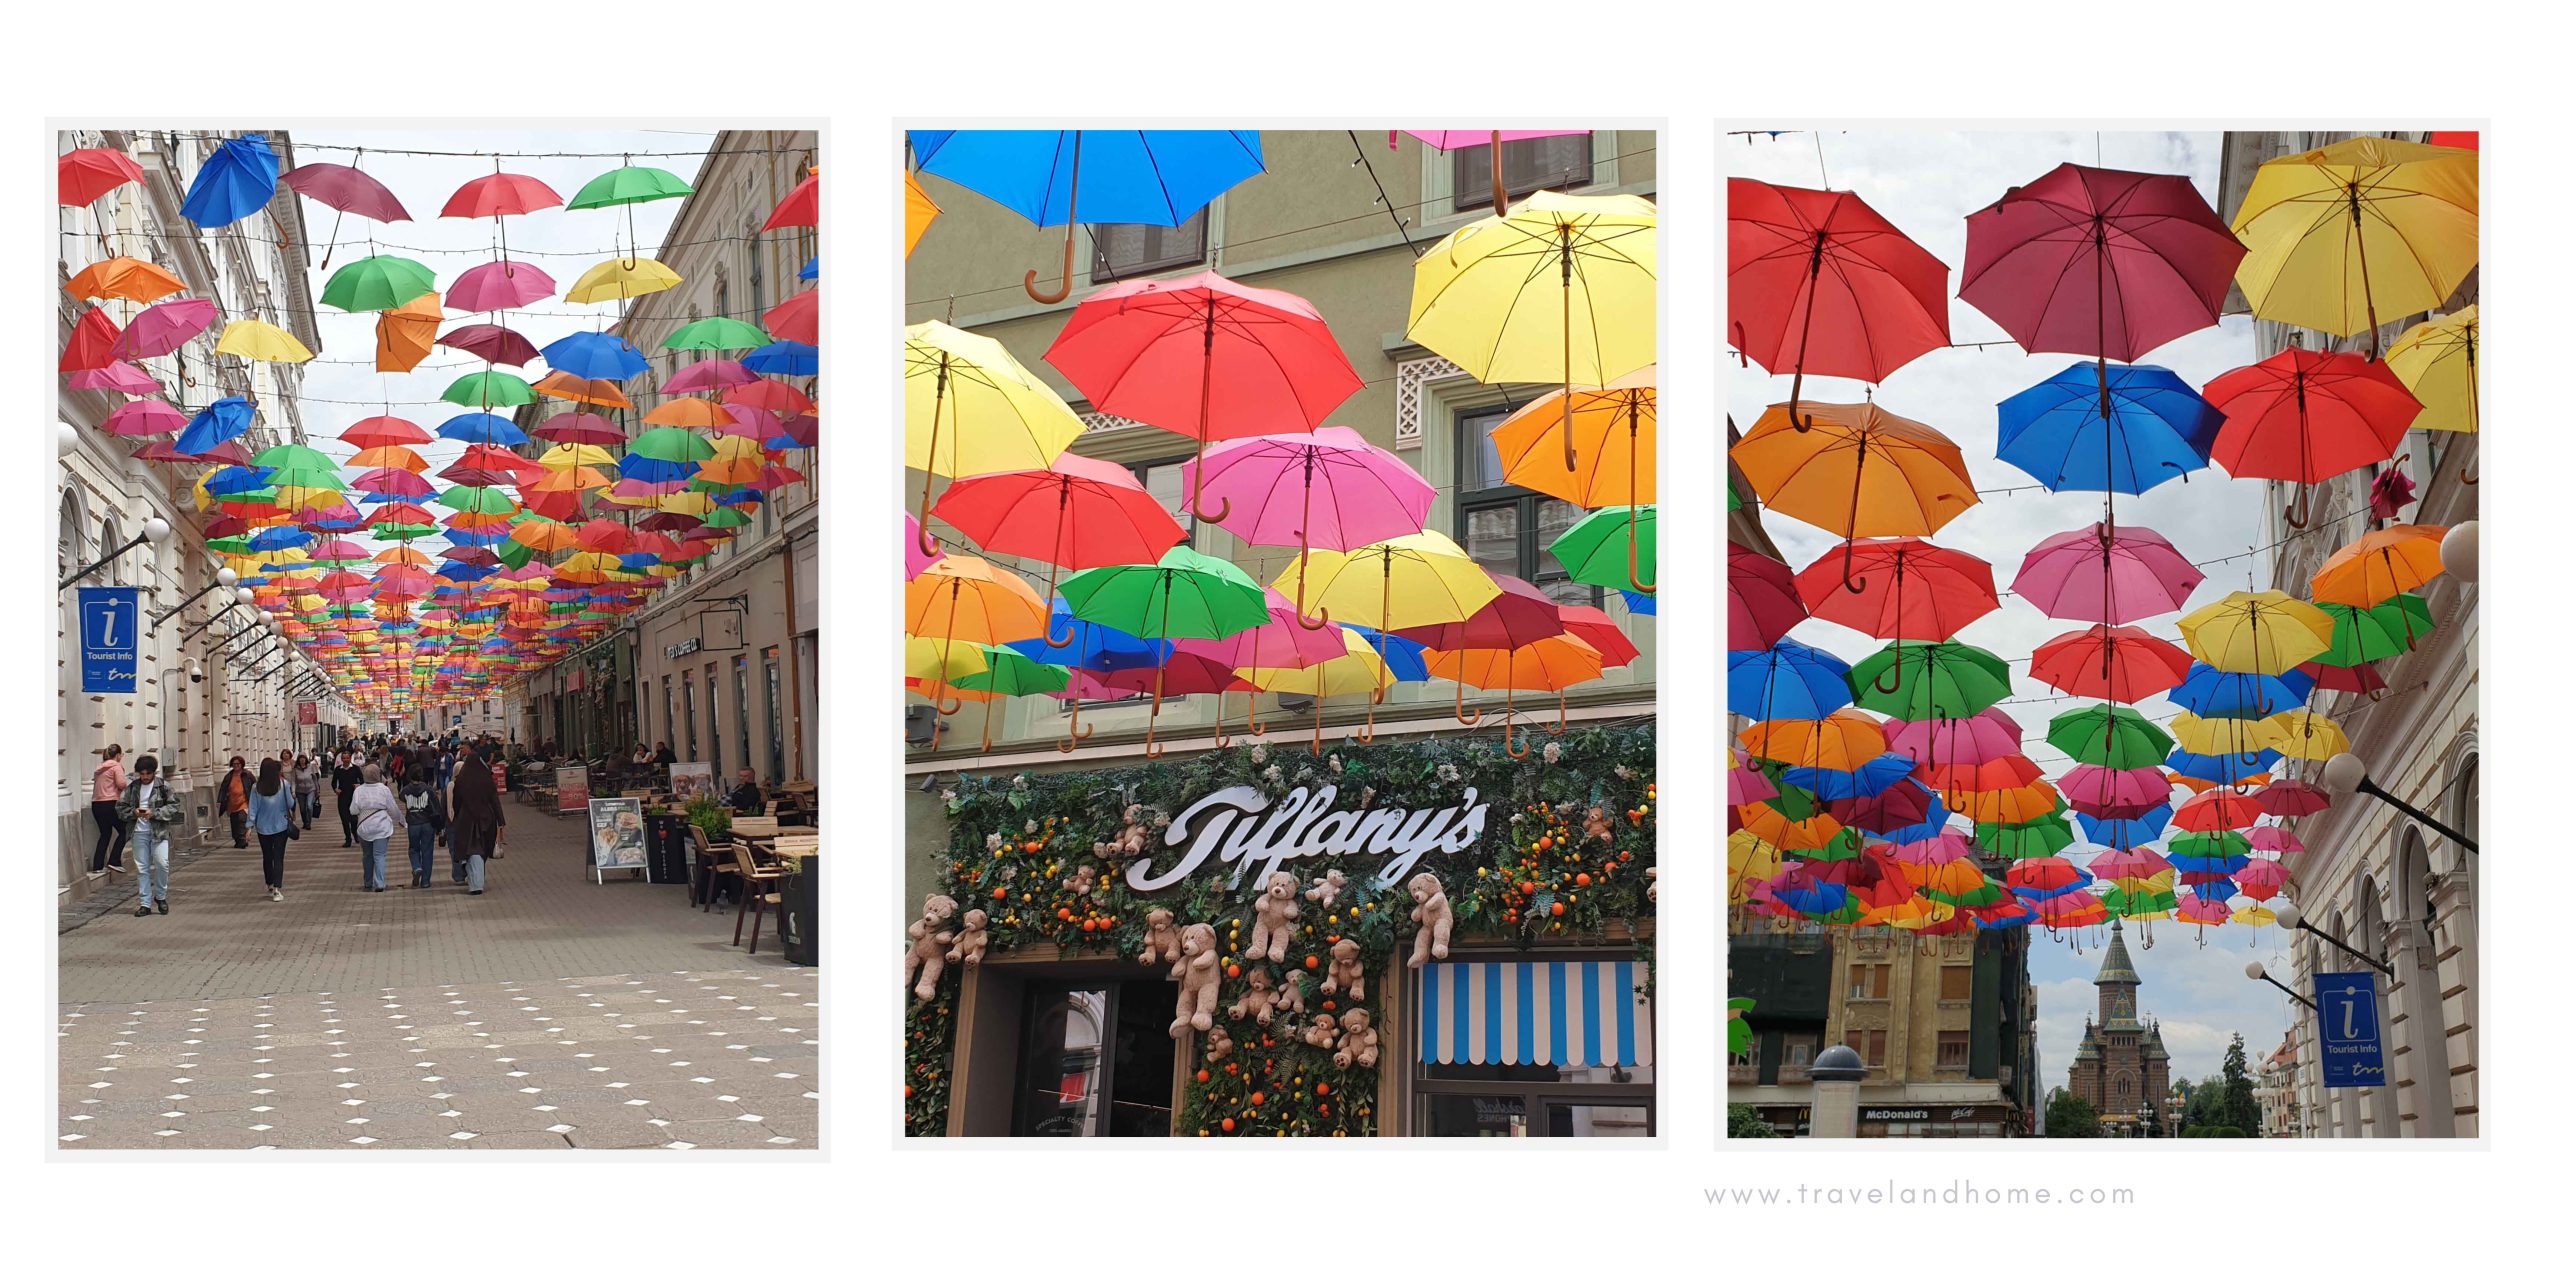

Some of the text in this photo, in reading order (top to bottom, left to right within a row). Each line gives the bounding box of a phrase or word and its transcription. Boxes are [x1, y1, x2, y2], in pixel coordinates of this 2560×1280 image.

[87, 651, 133, 660] Tourist Info
[1125, 784, 1490, 892] Tiffany's
[2327, 1044, 2378, 1054] Tourist Info
[1866, 1110, 1929, 1119] McDonald's
